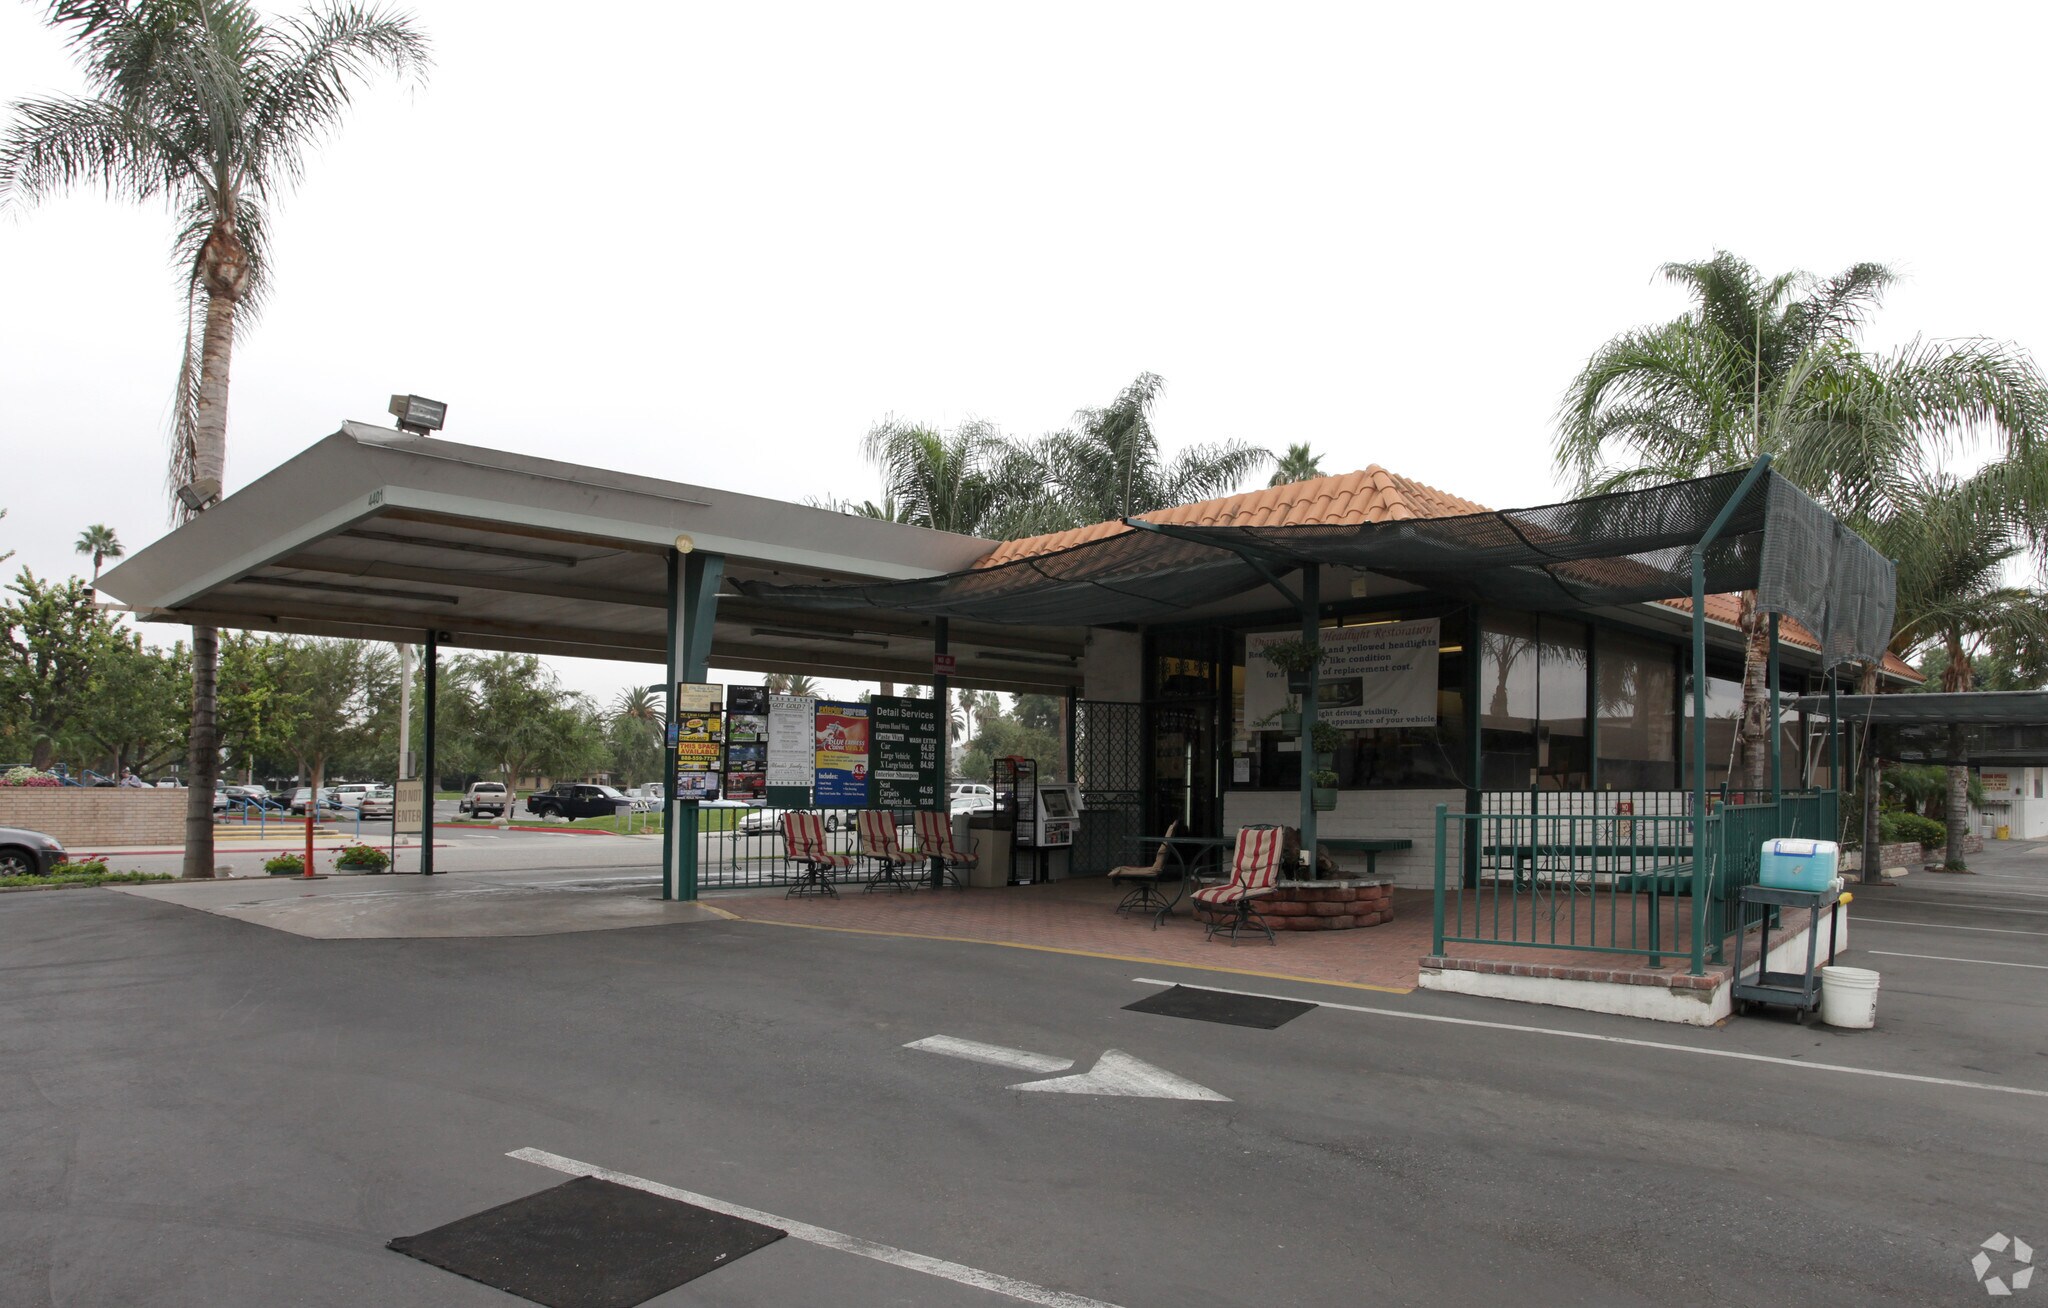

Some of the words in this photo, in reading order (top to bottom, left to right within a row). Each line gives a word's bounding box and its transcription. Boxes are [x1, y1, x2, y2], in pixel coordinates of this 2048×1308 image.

[1322, 628, 1370, 645] Headlight
[1374, 624, 1433, 640] Restoration
[1328, 645, 1345, 654] and
[1347, 642, 1386, 655] yellowed
[1388, 638, 1437, 651] headlights
[1329, 655, 1348, 665] like
[1349, 653, 1392, 664] condition
[1322, 667, 1333, 676] of
[1334, 663, 1390, 676] replacement
[1391, 662, 1414, 672] cost.
[877, 707, 900, 717] Detail
[901, 708, 934, 719] Services
[1335, 708, 1362, 719] driving
[1364, 707, 1400, 717] visibility.
[920, 723, 935, 732] 44.95
[1331, 717, 1374, 727] appearance
[1376, 716, 1385, 724] of
[1385, 717, 1405, 726] your
[877, 733, 892, 741] Paste
[923, 737, 937, 745] EXTRA
[881, 742, 891, 750] Car
[881, 752, 894, 760] Large
[895, 752, 910, 760] Vehicle
[920, 752, 935, 760] 74.95
[885, 760, 898, 770] Large
[898, 761, 914, 769] Vehicle
[875, 770, 897, 778] Interior
[897, 771, 919, 780] Shampoo
[879, 780, 891, 789] Seat
[397, 790, 406, 802] DO
[408, 789, 422, 802] NOT
[879, 788, 900, 798] Carpets
[919, 786, 934, 795] 44.95
[879, 796, 903, 807] Complete
[904, 797, 912, 805] Int.
[397, 809, 422, 823] ENTER
